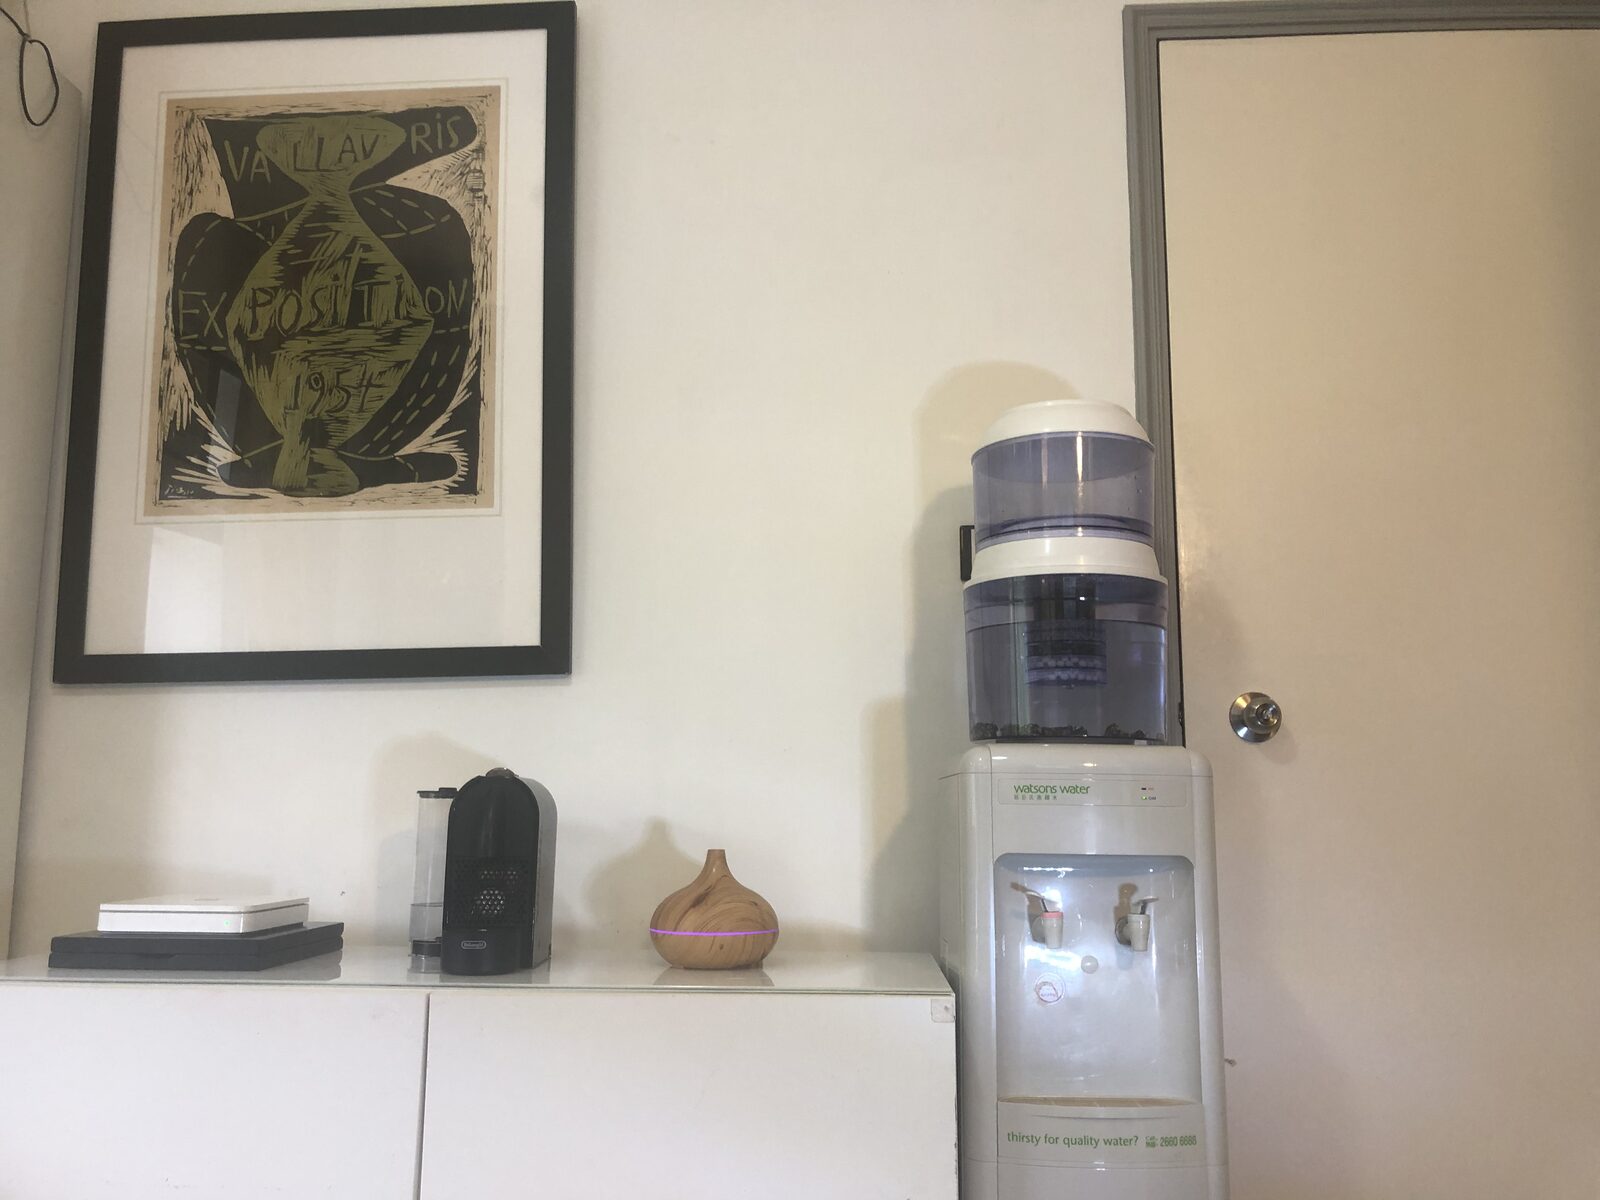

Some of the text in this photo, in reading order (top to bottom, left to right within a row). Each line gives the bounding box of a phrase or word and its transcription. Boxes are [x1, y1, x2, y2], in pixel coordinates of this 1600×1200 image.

[292, 360, 388, 415] 1954
[1013, 783, 1091, 794] watsons water
[1007, 1131, 1041, 1146] thirsty
[1044, 1133, 1059, 1145] for
[1063, 1135, 1100, 1149] quality
[1103, 1136, 1139, 1147] water?
